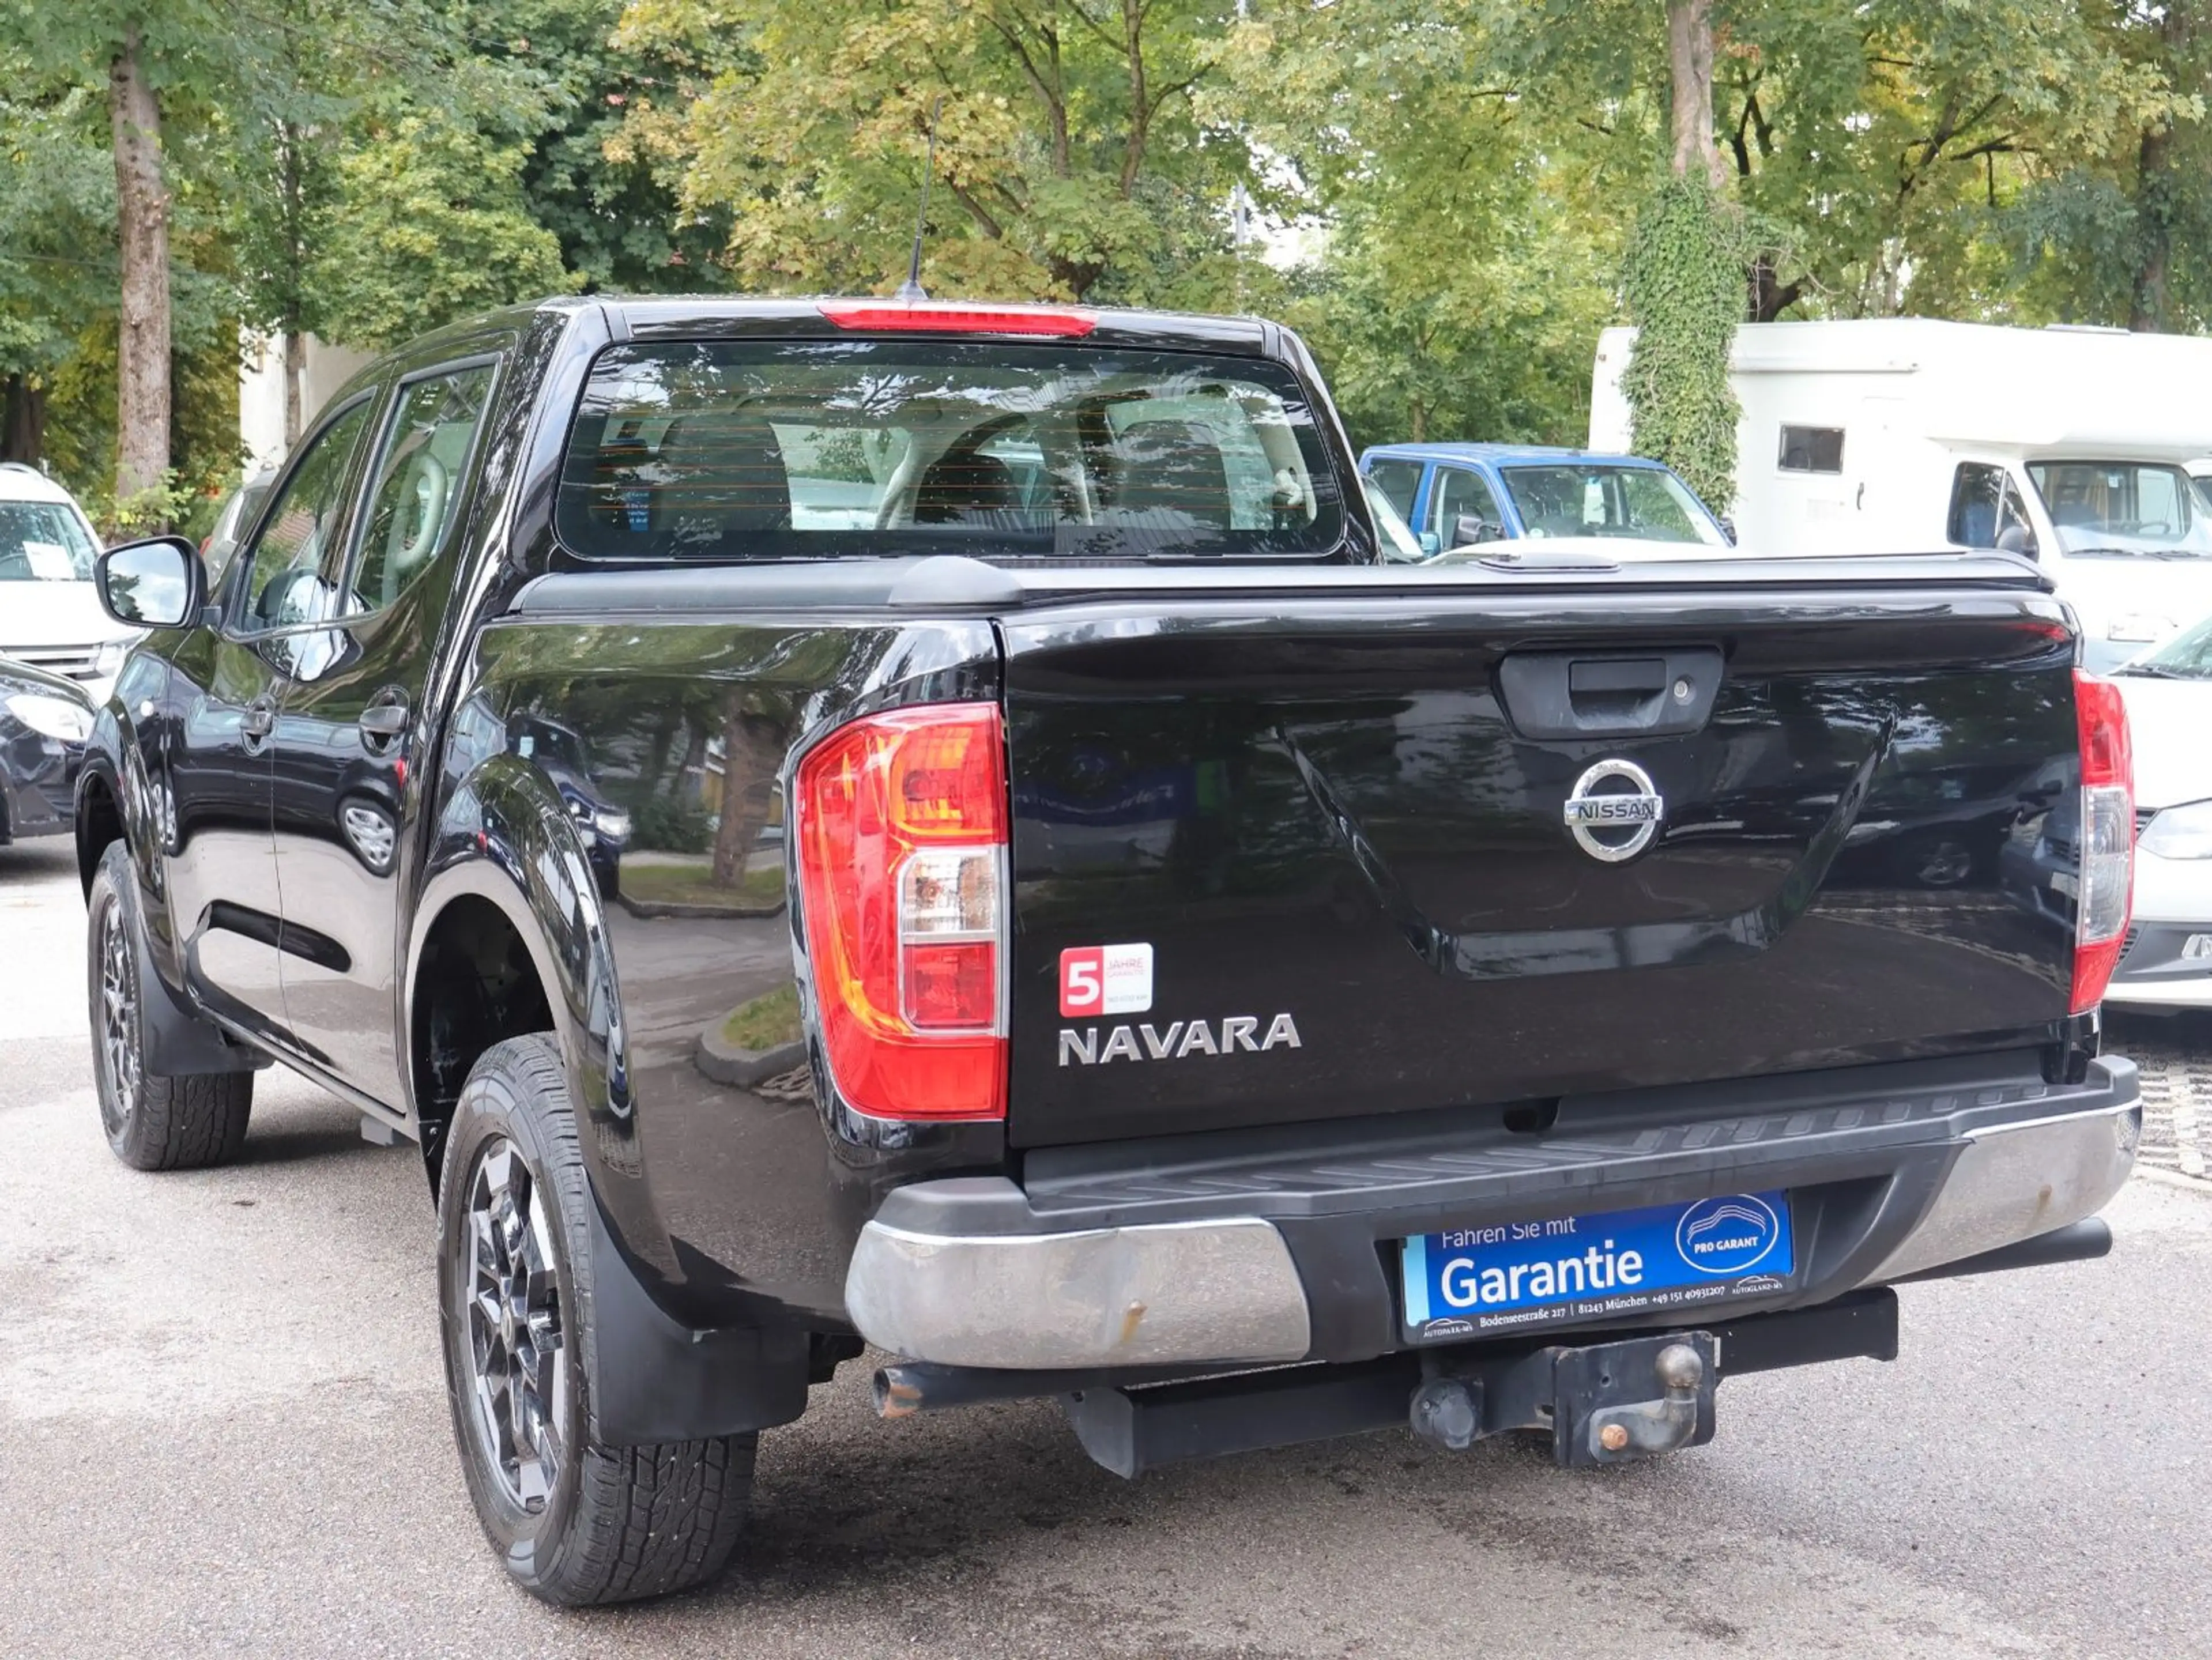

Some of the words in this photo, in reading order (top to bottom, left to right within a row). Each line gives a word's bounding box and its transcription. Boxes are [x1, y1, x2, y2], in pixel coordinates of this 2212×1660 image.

[1578, 802, 1655, 820] NISSAN
[1067, 961, 1100, 1005] 5
[1058, 1013, 1302, 1067] NAVARA
[1546, 1216, 1577, 1236] mit
[1694, 1242, 1714, 1254] PRO
[1716, 1236, 1758, 1251] GARANT
[1441, 1239, 1643, 1308] Garantie
[1479, 1308, 1549, 1328] Bodenseestraße
[1551, 1307, 1566, 1318] 217
[1578, 1300, 1603, 1314] 81243
[1606, 1296, 1648, 1310] München
[1652, 1293, 1668, 1305] +49
[1670, 1291, 1683, 1303] 151
[1684, 1286, 1725, 1301] 40931207
